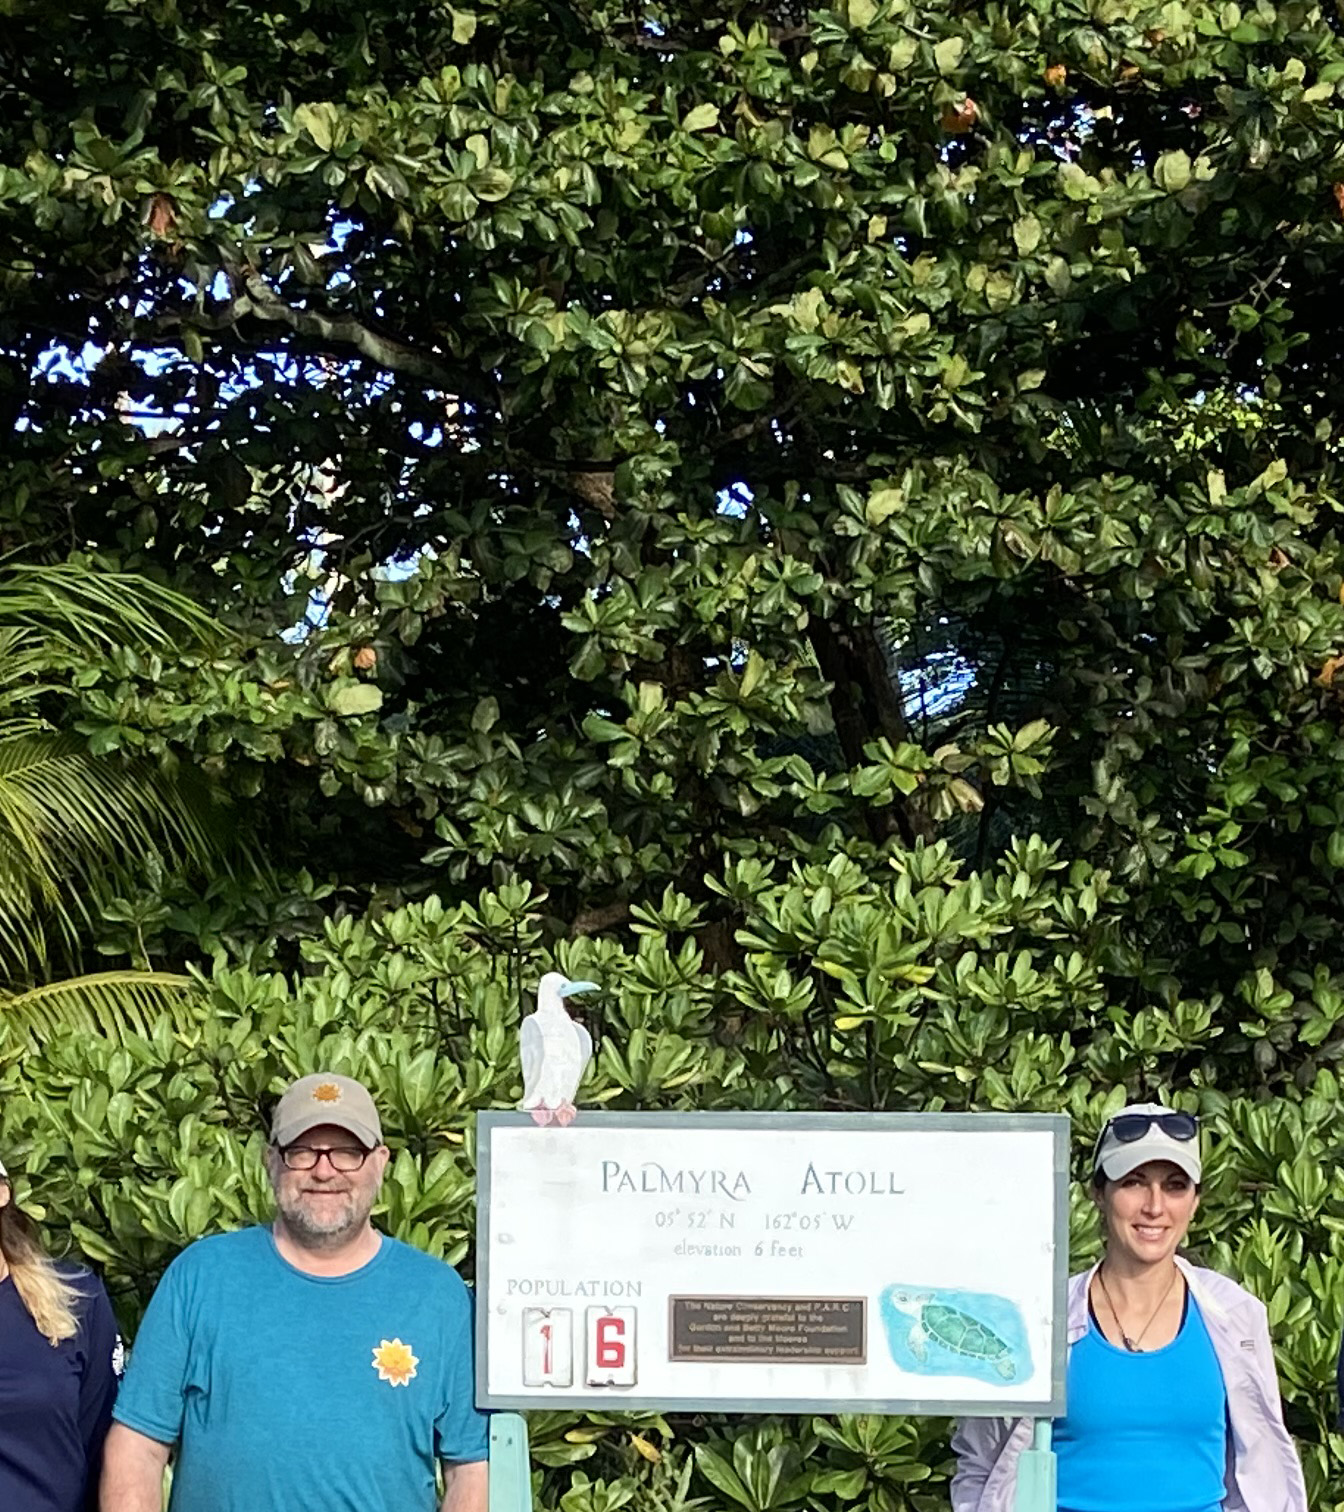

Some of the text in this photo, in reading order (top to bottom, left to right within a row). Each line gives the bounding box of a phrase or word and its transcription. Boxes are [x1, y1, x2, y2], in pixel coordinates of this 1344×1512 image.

[601, 1161, 905, 1201] PALMYRA ATOLL
[719, 1213, 735, 1229] N
[832, 1214, 855, 1230] W
[674, 1238, 803, 1257] elevation 6 feet
[506, 1279, 643, 1297] POPULATION
